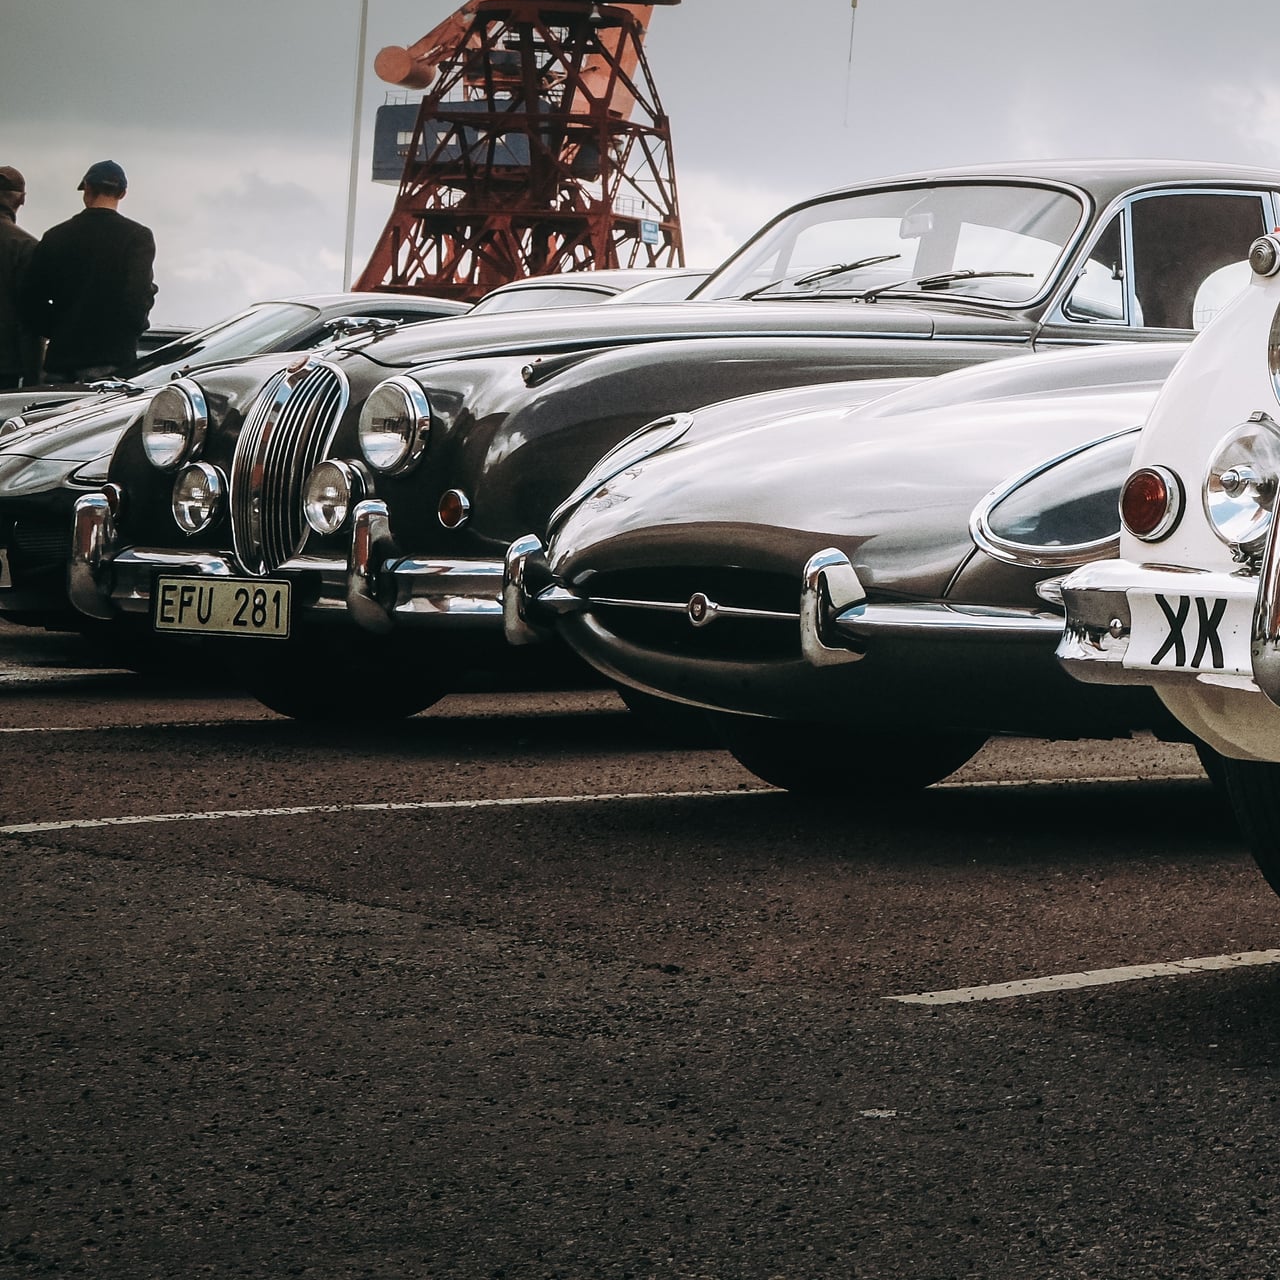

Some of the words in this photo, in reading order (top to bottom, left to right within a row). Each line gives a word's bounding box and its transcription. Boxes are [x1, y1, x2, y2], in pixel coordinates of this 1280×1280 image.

[160, 584, 214, 625] EFU
[233, 587, 281, 629] 281
[1150, 593, 1228, 669] XK
